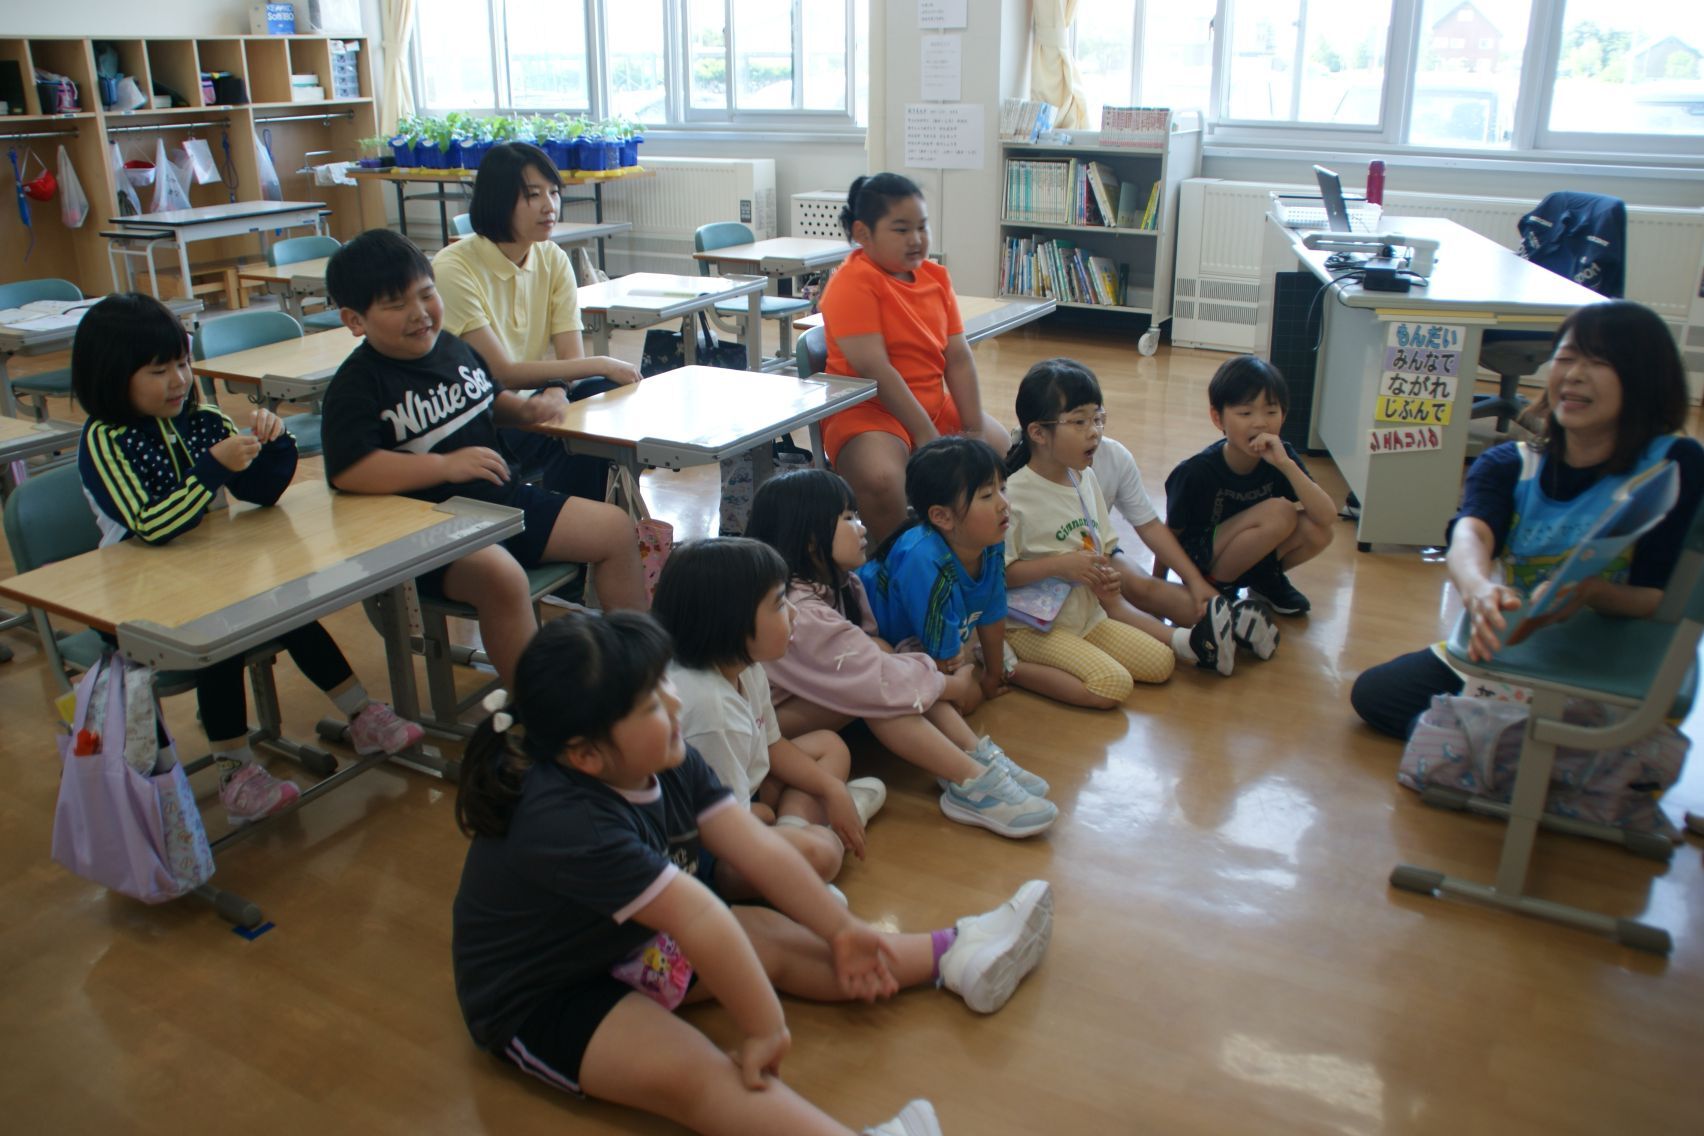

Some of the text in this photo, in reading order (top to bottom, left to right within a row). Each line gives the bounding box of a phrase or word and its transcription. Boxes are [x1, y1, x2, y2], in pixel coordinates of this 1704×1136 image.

[1396, 324, 1457, 349] もんだい
[1393, 349, 1455, 373] みんなで
[1388, 373, 1450, 399] ながれ
[380, 382, 466, 442] White
[1385, 398, 1447, 422] じぶんで
